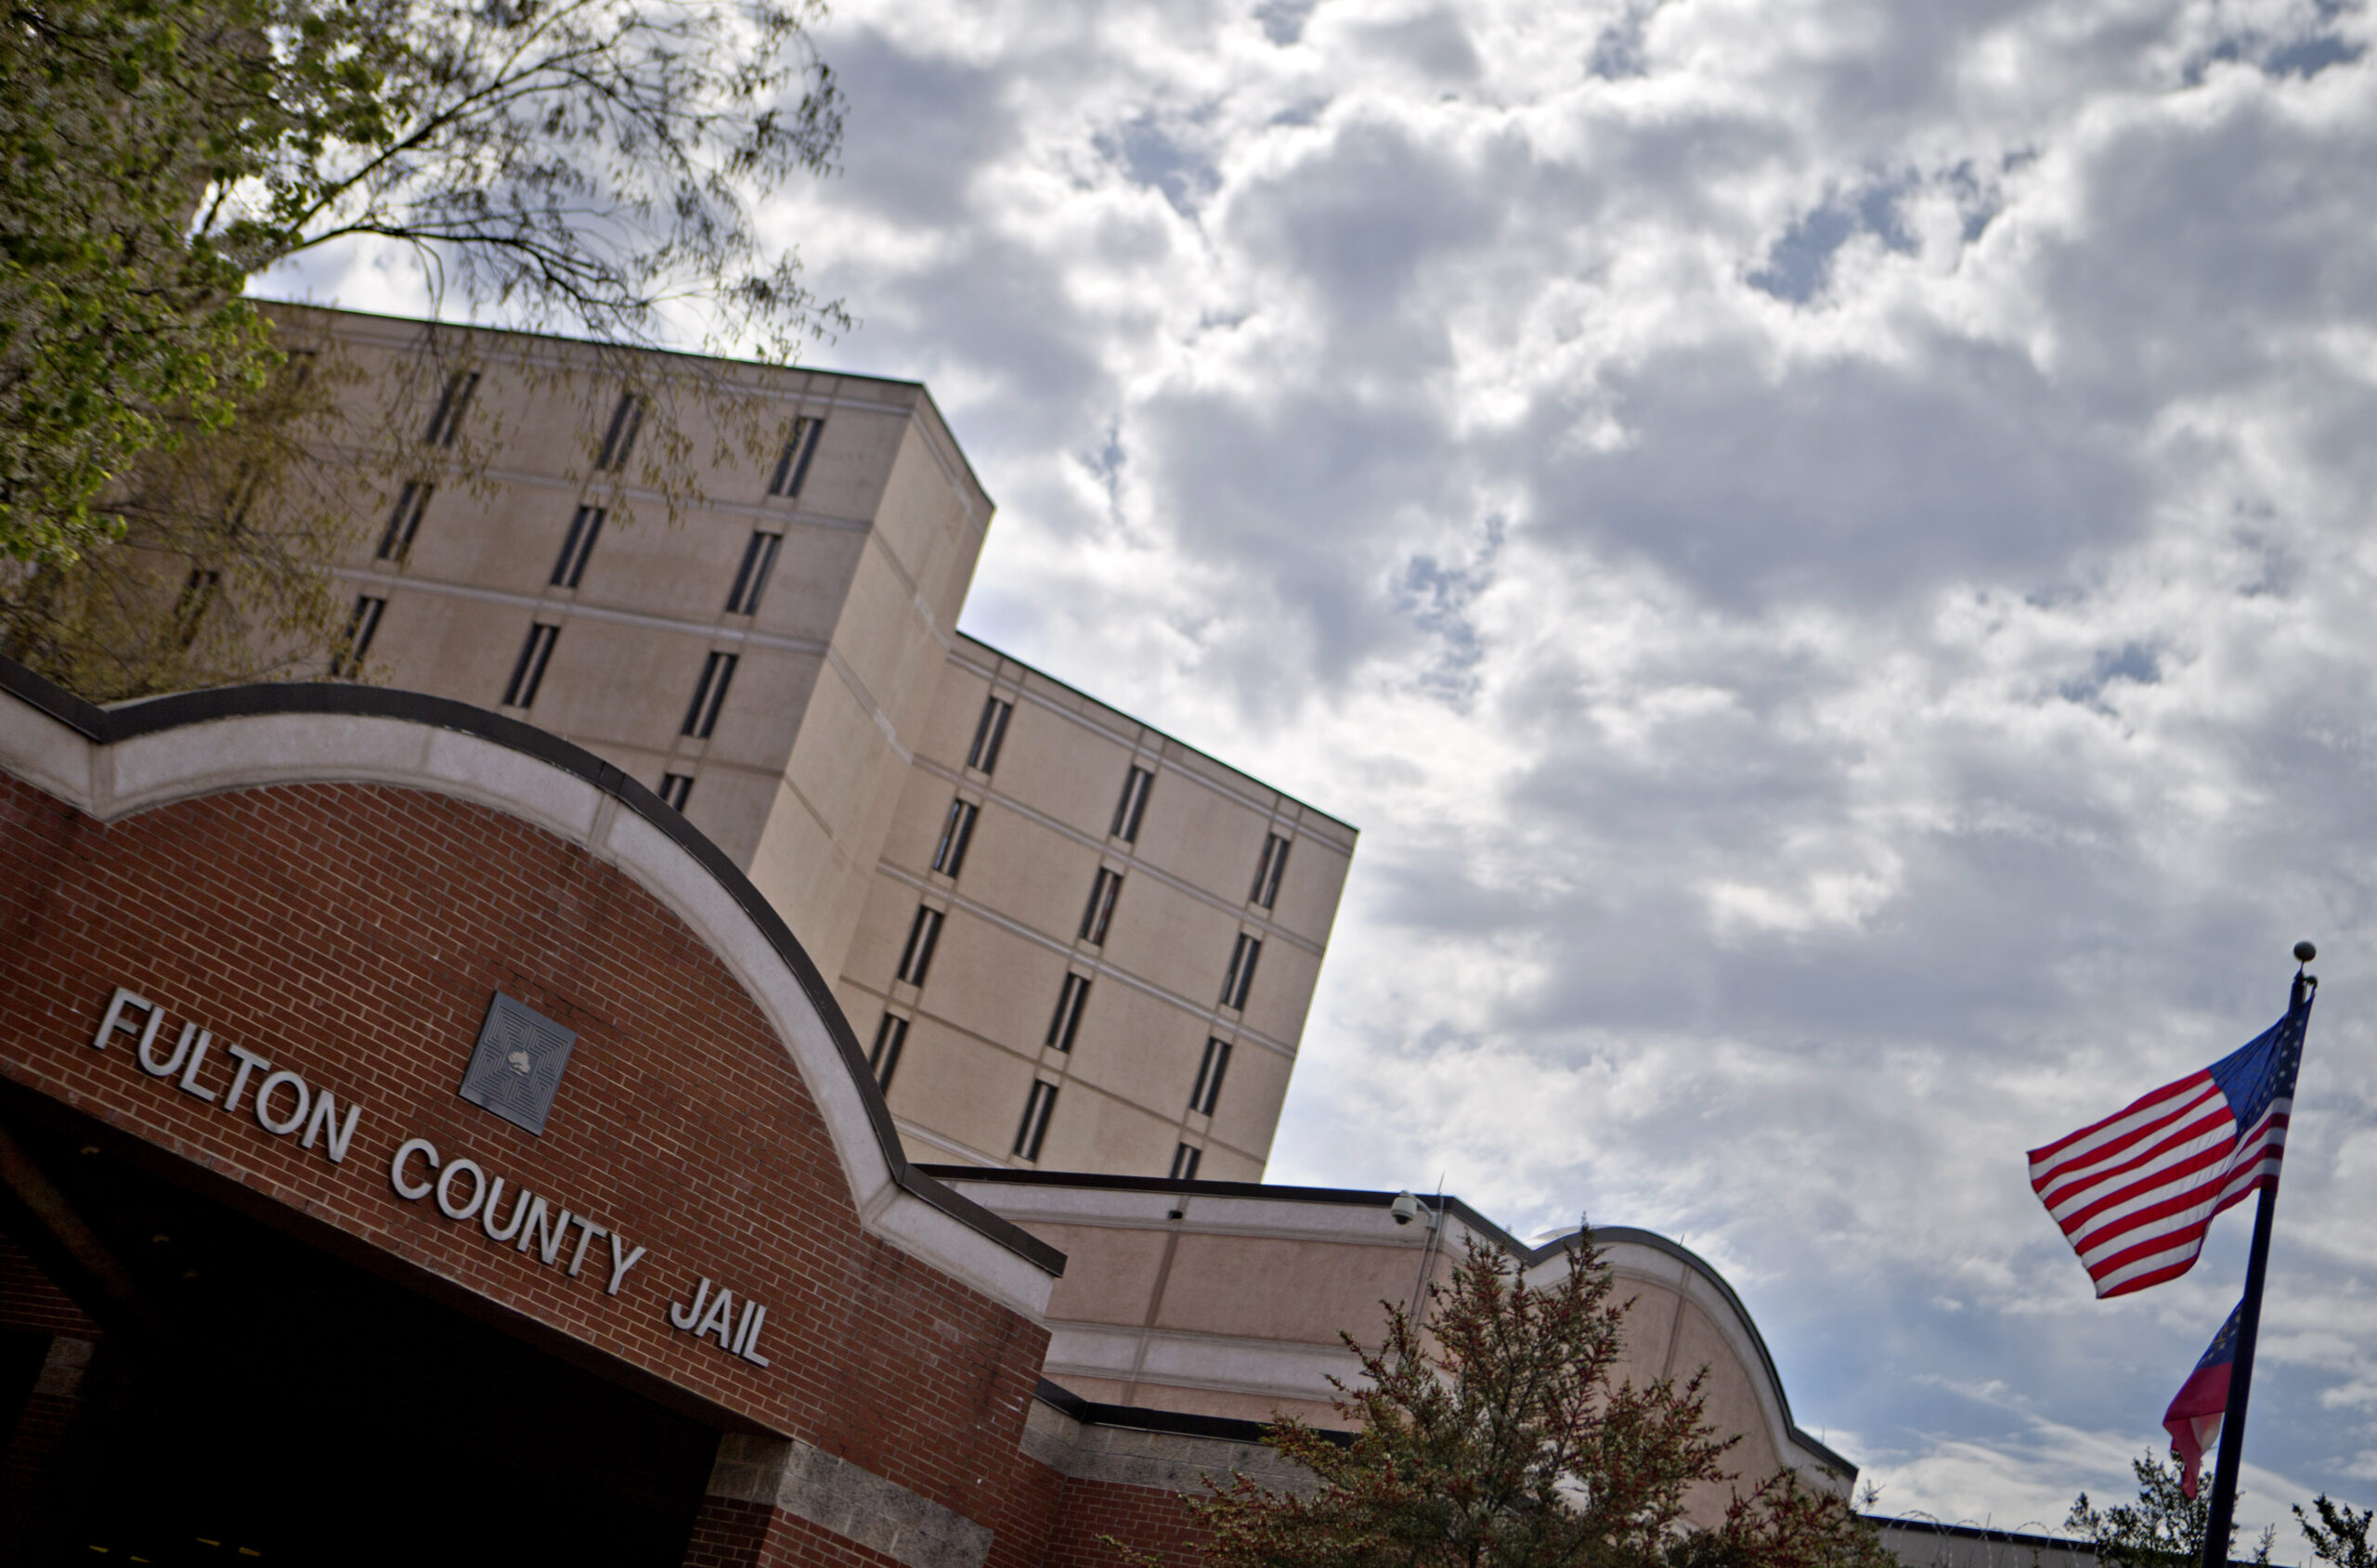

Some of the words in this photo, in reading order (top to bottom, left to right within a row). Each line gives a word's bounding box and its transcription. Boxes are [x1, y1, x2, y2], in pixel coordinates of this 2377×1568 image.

[93, 987, 361, 1163] FULTON
[390, 1137, 646, 1296] COUNTY
[669, 1277, 769, 1367] JAIL
